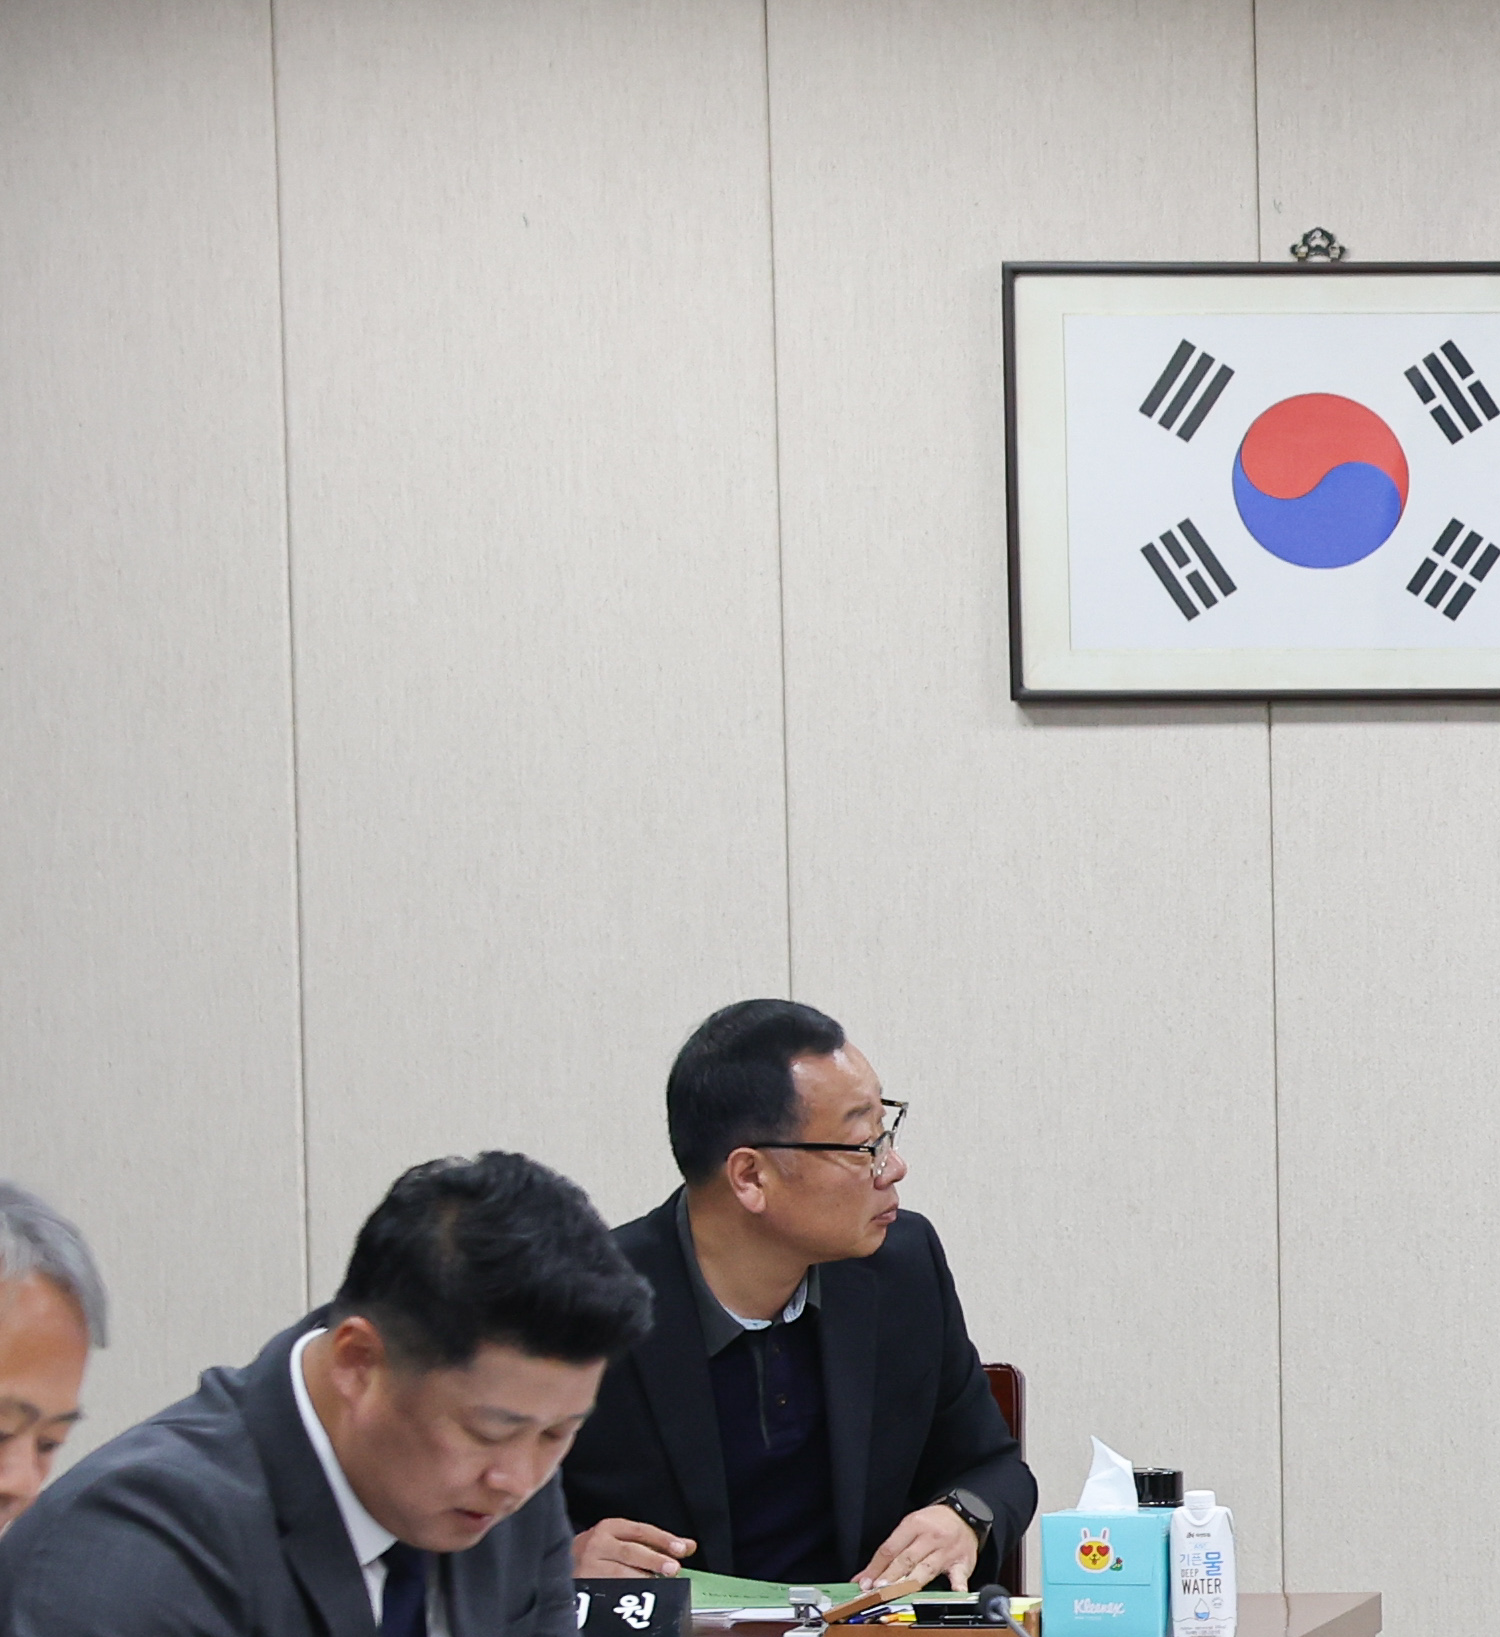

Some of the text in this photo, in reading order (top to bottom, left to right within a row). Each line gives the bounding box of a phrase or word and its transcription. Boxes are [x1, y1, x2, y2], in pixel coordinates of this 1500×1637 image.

[1202, 1551, 1224, 1577] 물
[1181, 1568, 1199, 1578] DEEP
[1182, 1578, 1222, 1595] WATER
